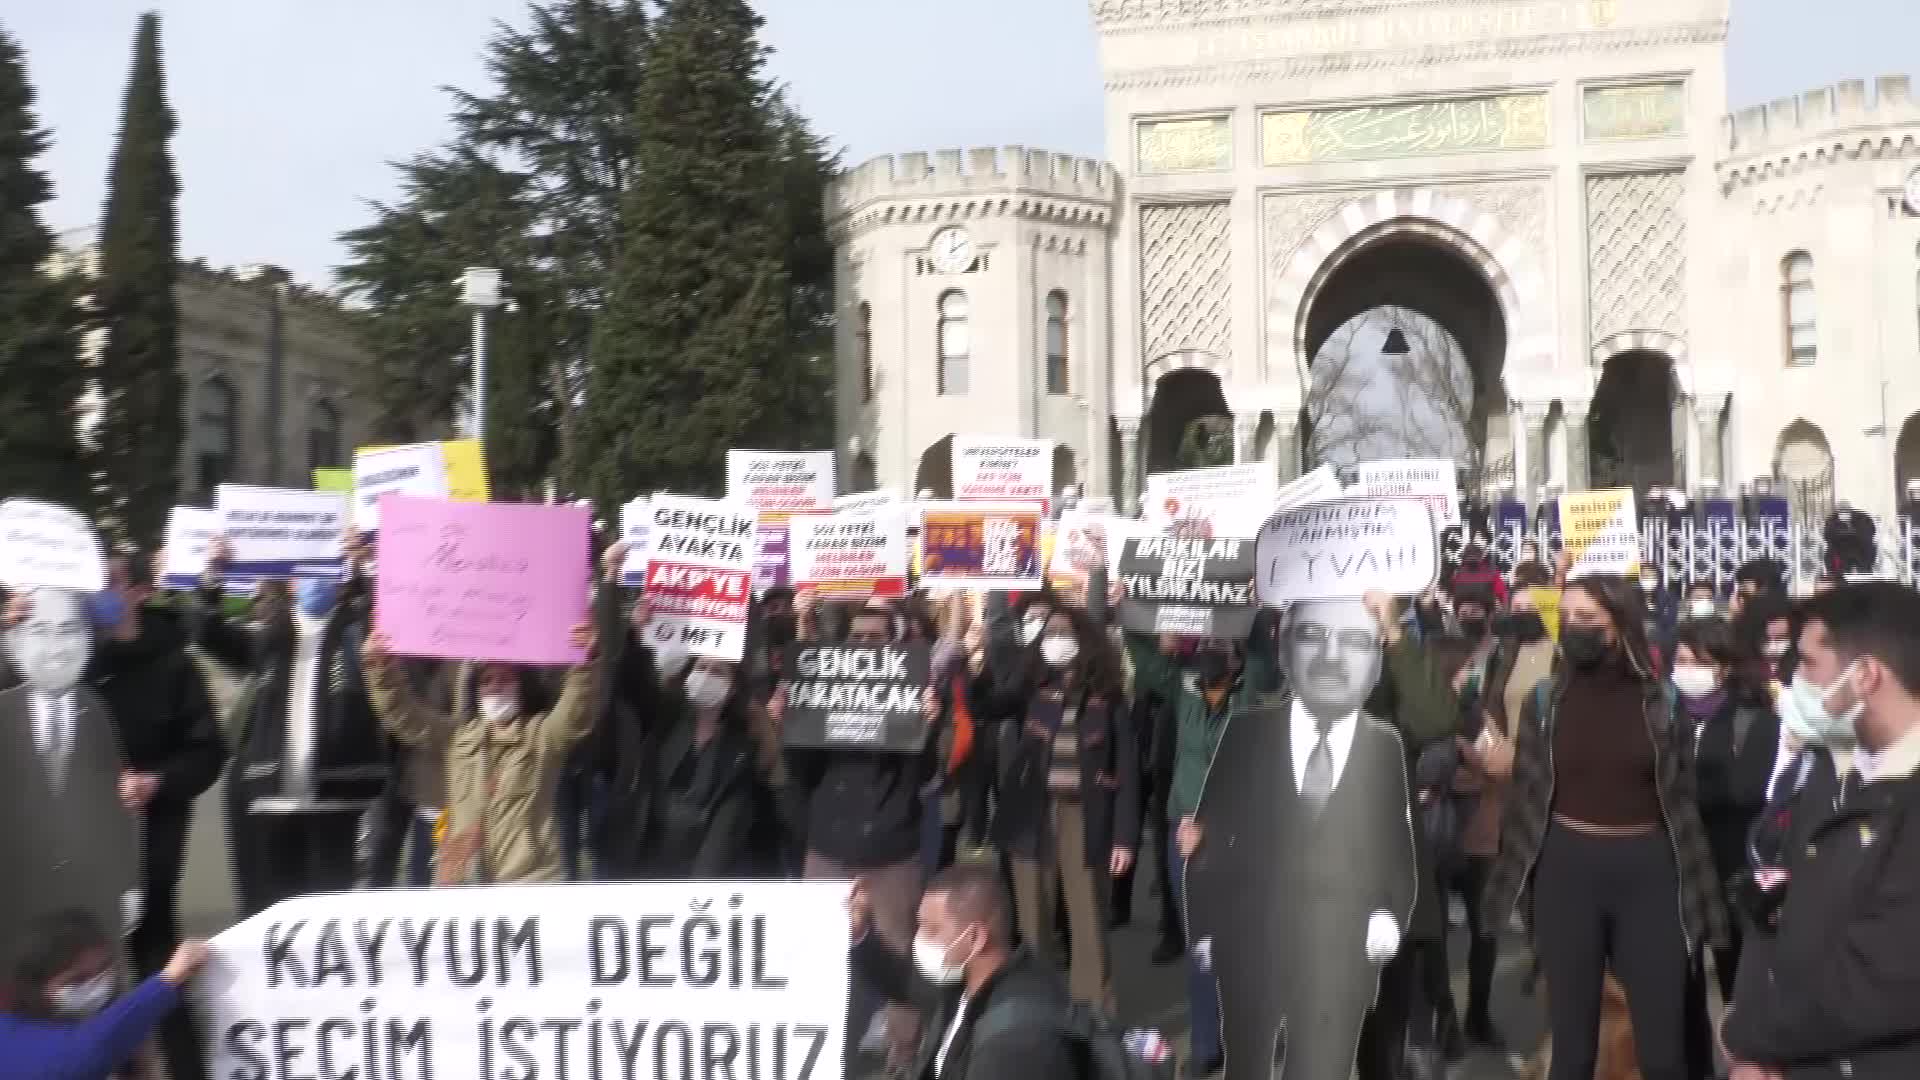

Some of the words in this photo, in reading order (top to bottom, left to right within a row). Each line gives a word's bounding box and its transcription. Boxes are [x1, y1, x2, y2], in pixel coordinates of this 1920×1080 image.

[655, 508, 754, 540] GENÇLİK
[659, 535, 743, 562] AYAKTA
[1135, 539, 1240, 560] BASKILAR
[650, 565, 744, 597] AKP'YE
[1122, 574, 1247, 603] YILDIRAMAZ
[646, 590, 745, 620] DİRENİYOR!
[681, 627, 727, 649] MFT
[798, 645, 908, 681] GENÇLİK
[787, 681, 922, 714] YARATACAK
[263, 914, 543, 988] KAYYUM
[590, 893, 788, 989] DEĞİL
[475, 997, 831, 1080] İSTİYORUZ
